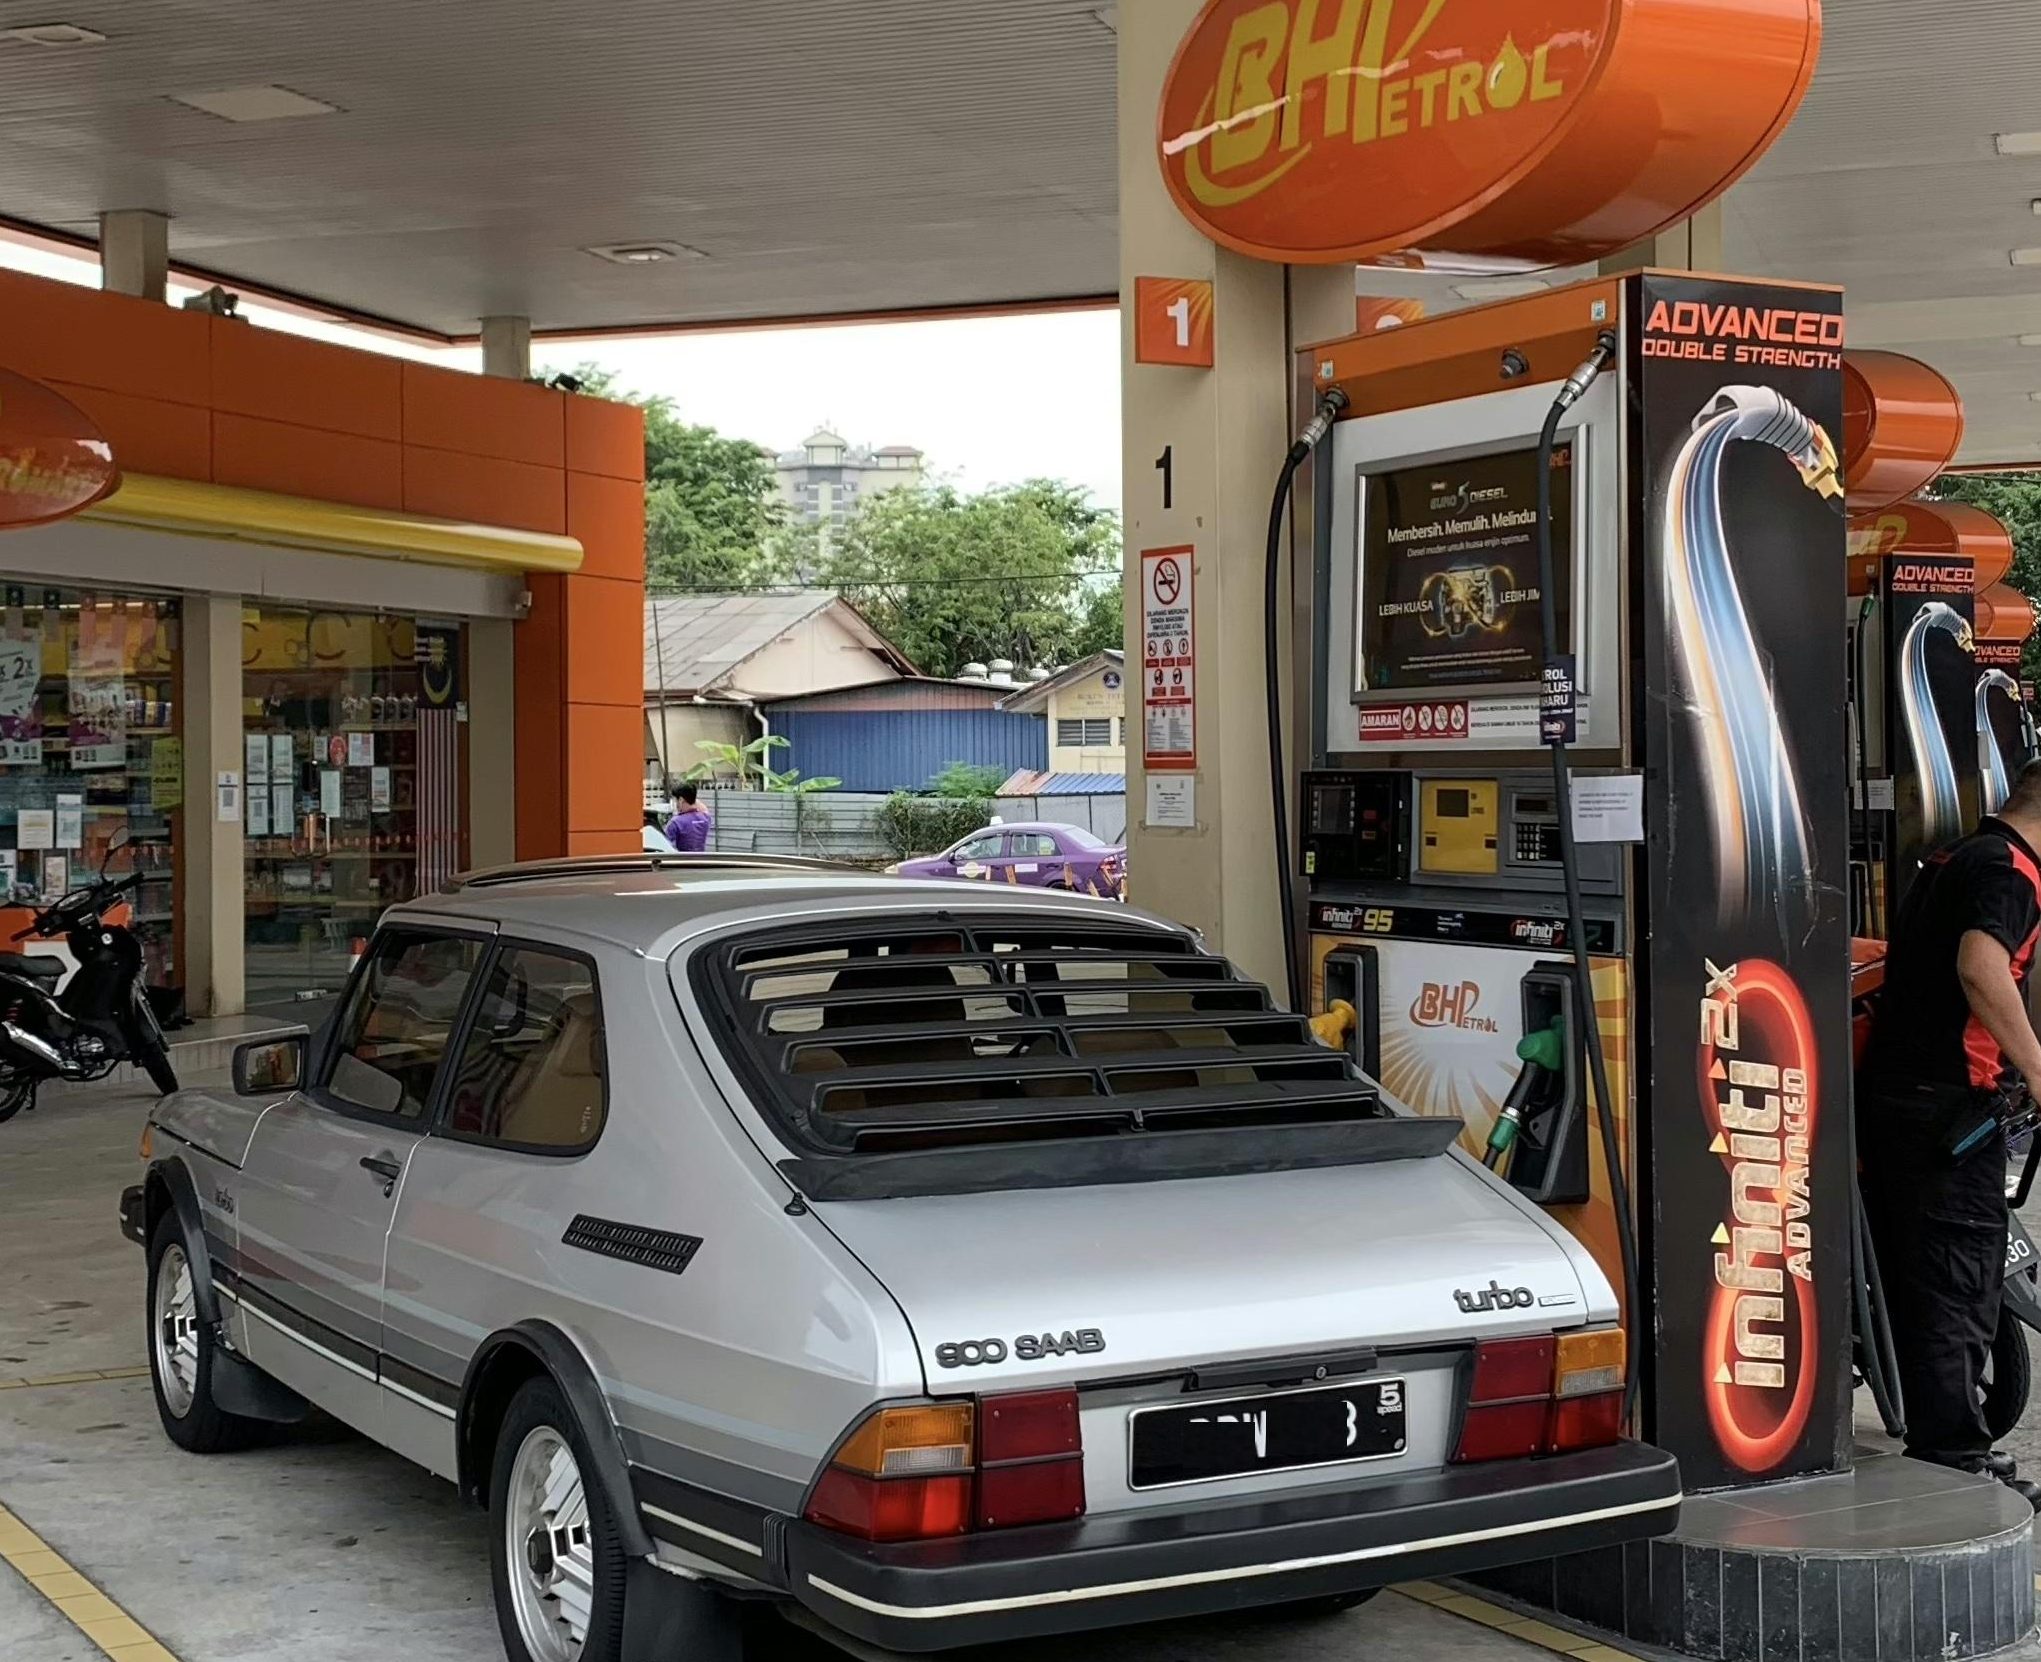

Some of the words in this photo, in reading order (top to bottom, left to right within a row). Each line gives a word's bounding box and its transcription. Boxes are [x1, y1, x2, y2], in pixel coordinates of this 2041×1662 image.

[1167, 297, 1189, 346] 1
[1646, 300, 1842, 346] ADVANCED
[1642, 338, 1727, 361] DOUBLE
[1735, 345, 1841, 370] STRENGTH
[1156, 445, 1172, 509] 1
[1892, 582, 1927, 593] DOUBLE
[1893, 565, 1975, 583] ADVANCED
[1975, 646, 2020, 656] DVANCED
[1361, 714, 1400, 727] AMARAN
[1363, 909, 1394, 931] 95
[1782, 1067, 1812, 1281] ADVANCED
[2004, 1238, 2030, 1268] 30
[1453, 1280, 1534, 1313] turbo
[935, 1338, 1008, 1369] 900
[1015, 1328, 1106, 1360] SAAB
[1380, 1383, 1400, 1406] 5
